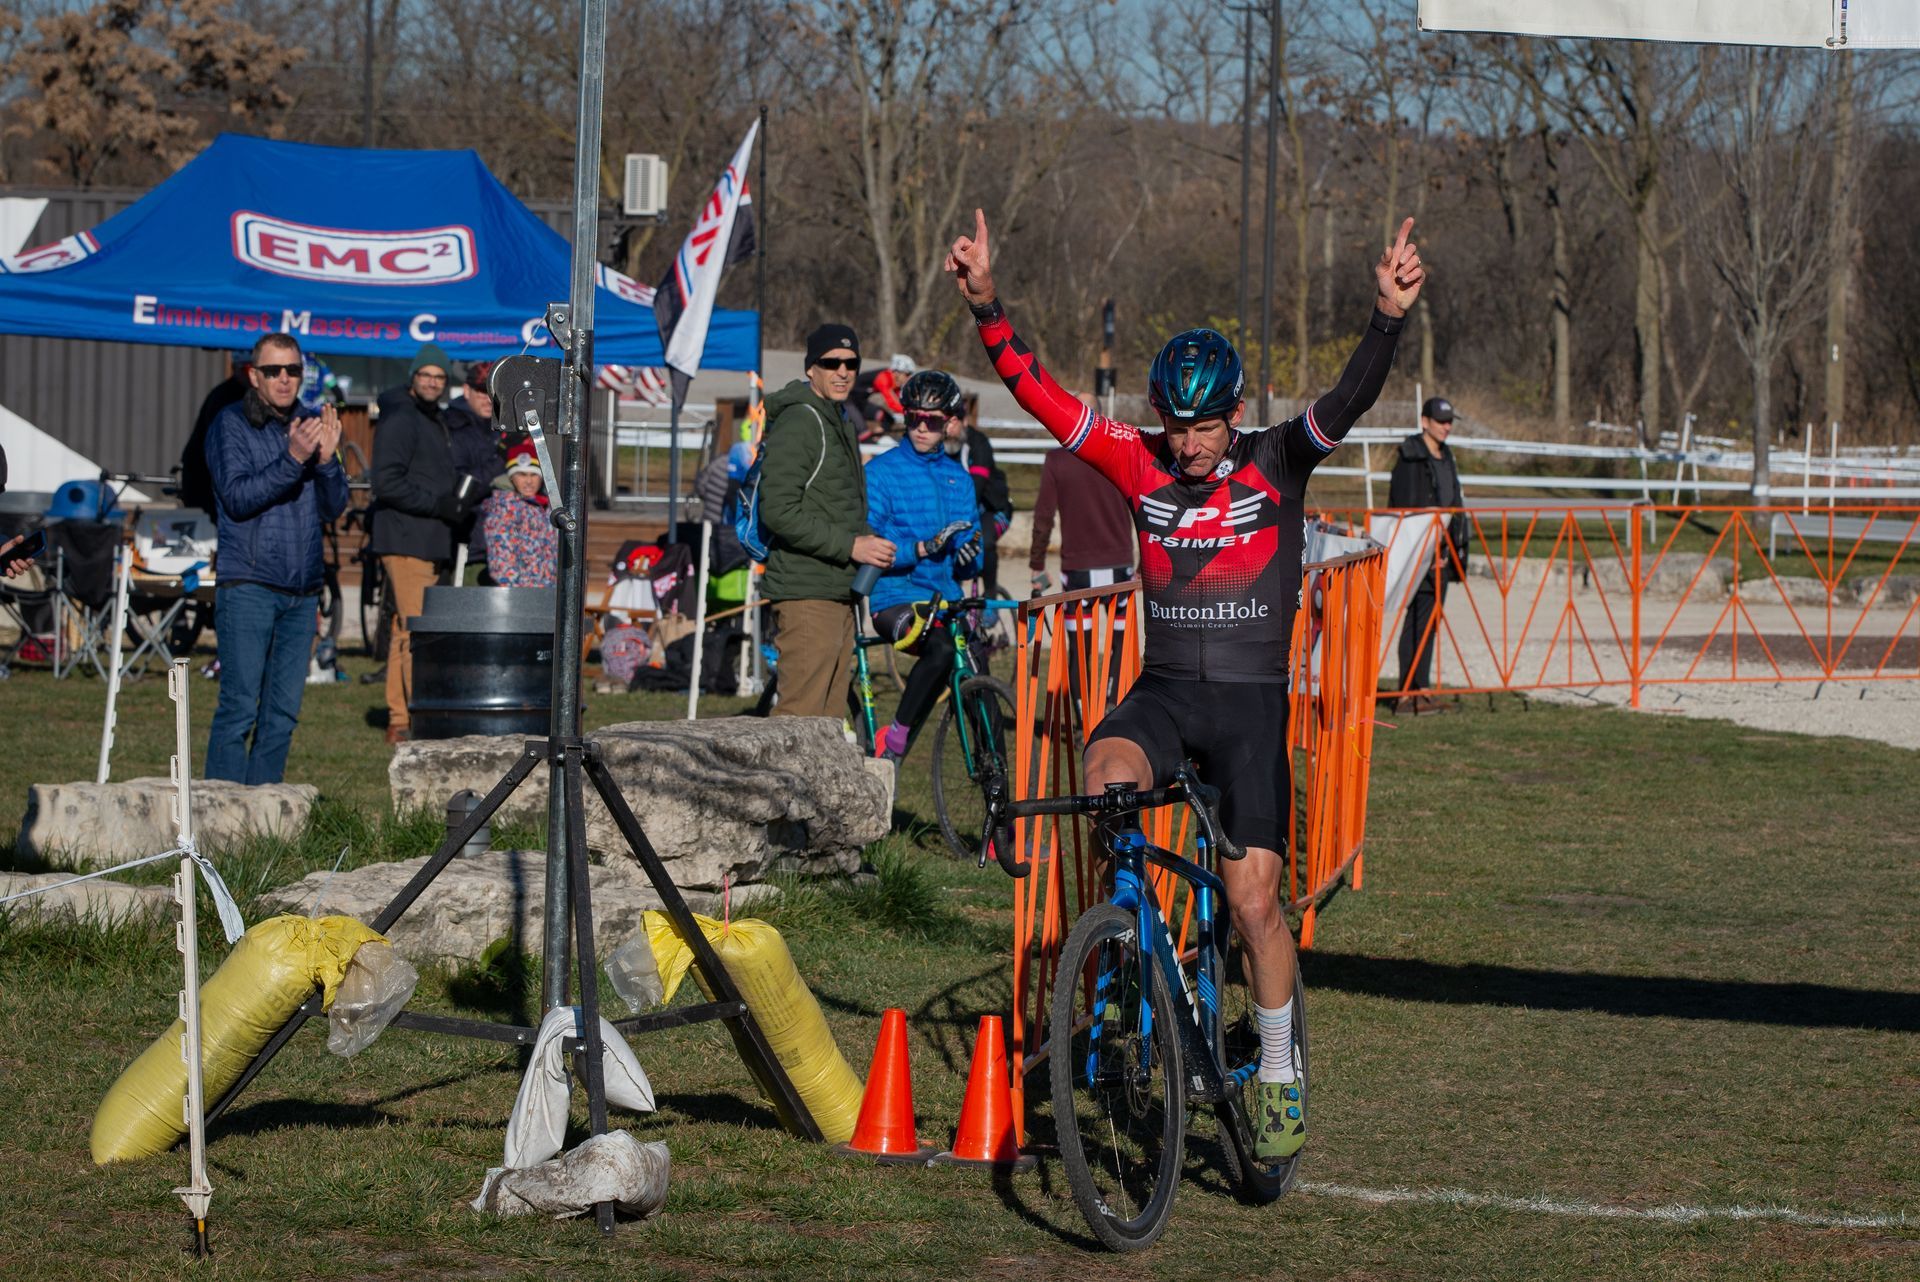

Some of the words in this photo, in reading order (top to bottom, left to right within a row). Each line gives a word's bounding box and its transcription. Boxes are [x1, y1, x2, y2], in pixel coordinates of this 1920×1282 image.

[133, 294, 271, 332] Elmhurst
[281, 309, 402, 340] Masters
[408, 313, 518, 345] Competition
[1147, 531, 1258, 549] PSIMET
[1149, 598, 1269, 620] ButtonHole
